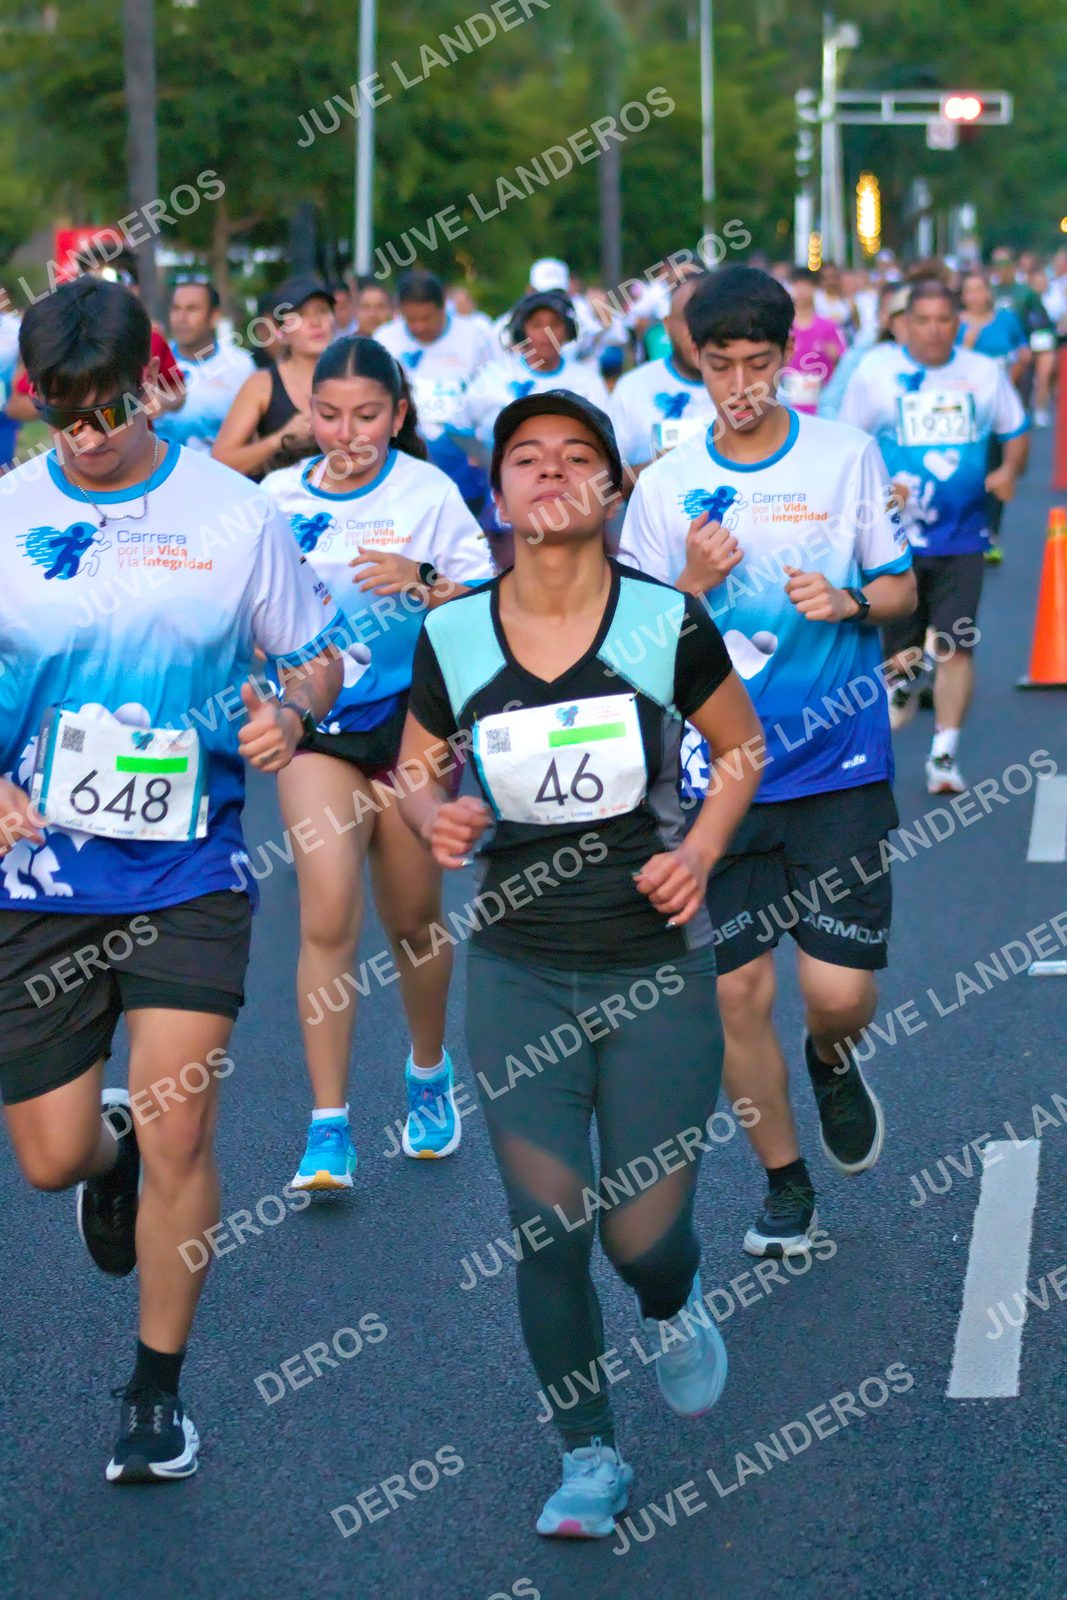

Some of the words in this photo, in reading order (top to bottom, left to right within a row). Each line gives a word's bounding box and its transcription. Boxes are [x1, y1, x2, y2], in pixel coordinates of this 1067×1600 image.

[910, 415, 967, 438] 1932
[752, 492, 806, 504] Carrera
[783, 503, 808, 513] Vida
[346, 519, 394, 530] Carrera
[772, 511, 828, 524] Integridad
[117, 530, 187, 545] Carrera
[158, 545, 188, 557] Vida
[143, 556, 213, 571] Integridad
[534, 752, 604, 806] 46
[69, 769, 172, 824] 648
